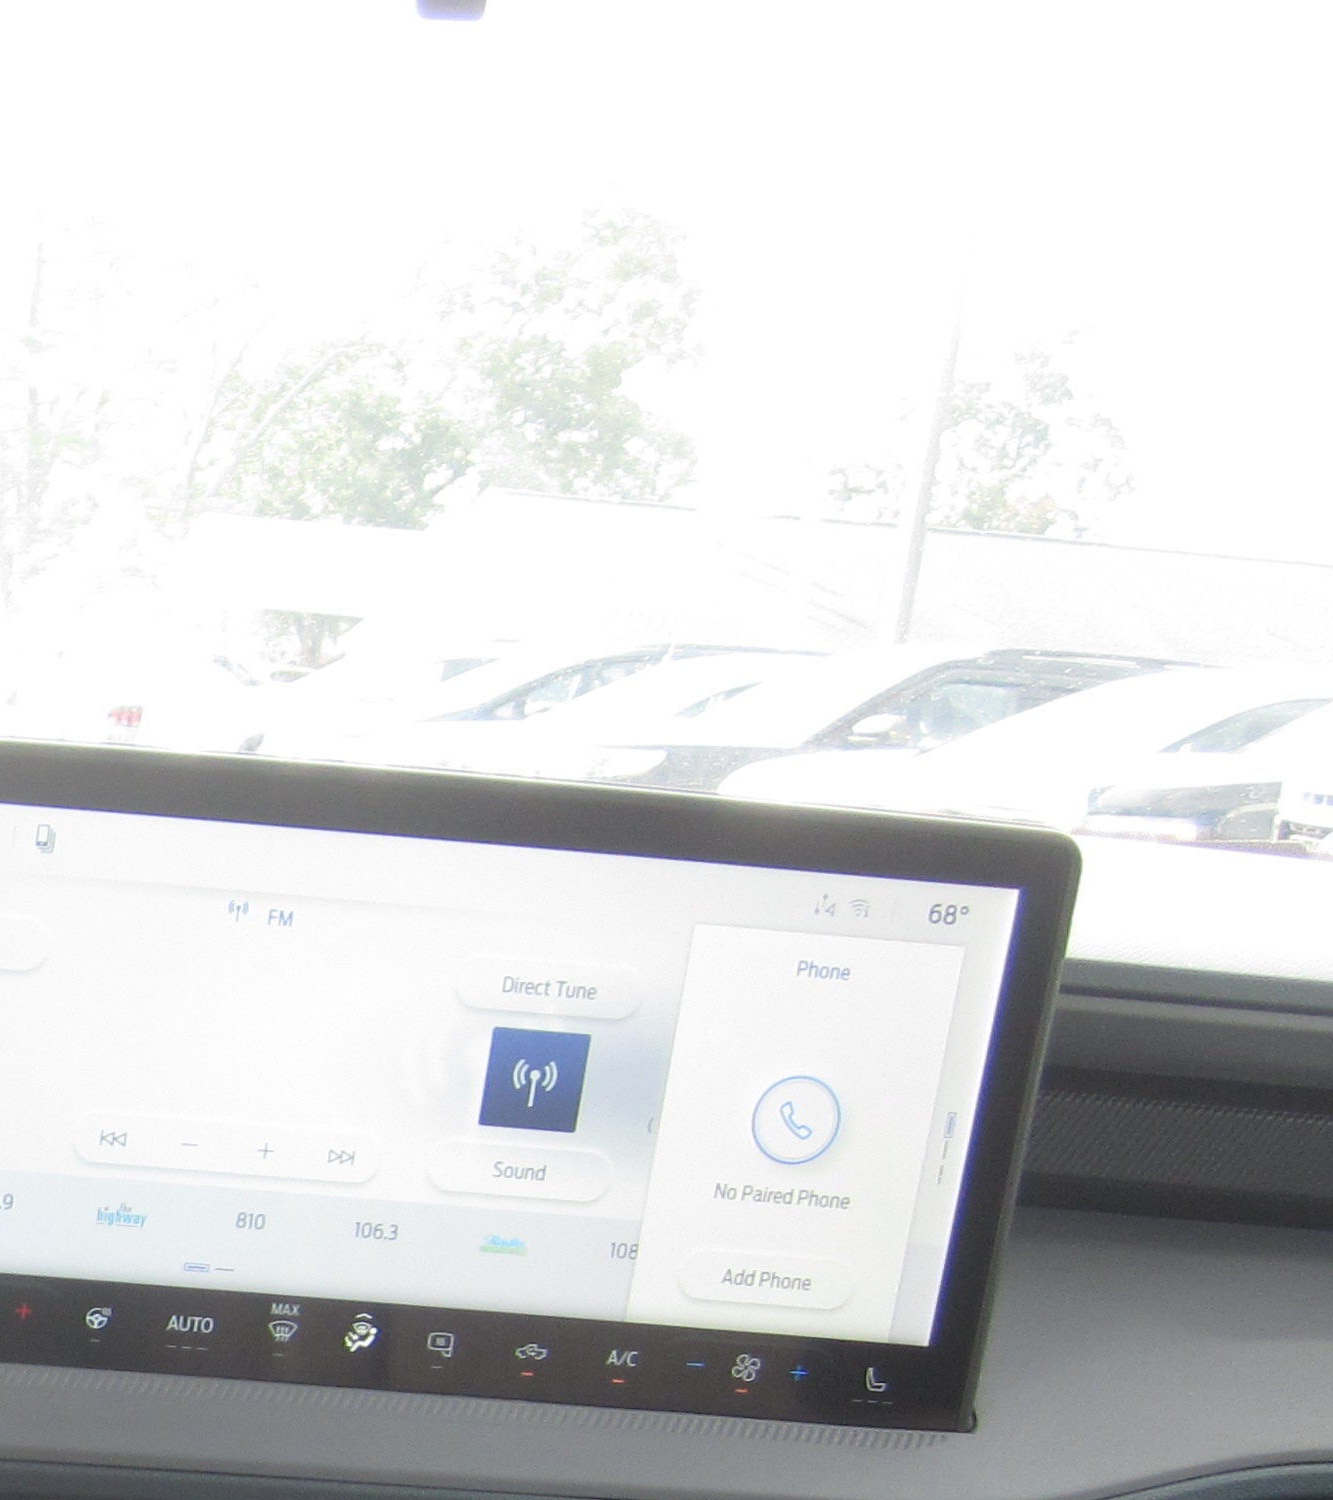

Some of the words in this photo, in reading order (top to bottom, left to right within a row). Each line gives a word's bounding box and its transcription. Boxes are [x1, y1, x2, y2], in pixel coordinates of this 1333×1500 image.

[267, 909, 294, 927] FM
[928, 903, 970, 926] 68°
[795, 960, 851, 982] Phone
[501, 975, 550, 998] Direct
[554, 979, 597, 1001] Tune
[492, 1160, 547, 1182] Sound
[714, 1182, 737, 1202] No
[740, 1183, 793, 1206] Paired
[796, 1189, 851, 1211] Phone
[97, 1207, 147, 1228] highway
[235, 1212, 266, 1232] 810
[354, 1221, 399, 1241] 106.3
[721, 1267, 756, 1288] Add
[759, 1270, 812, 1292] Phone
[270, 1302, 301, 1316] MAX
[167, 1315, 214, 1335] AUTO
[607, 1348, 639, 1369] A/C
